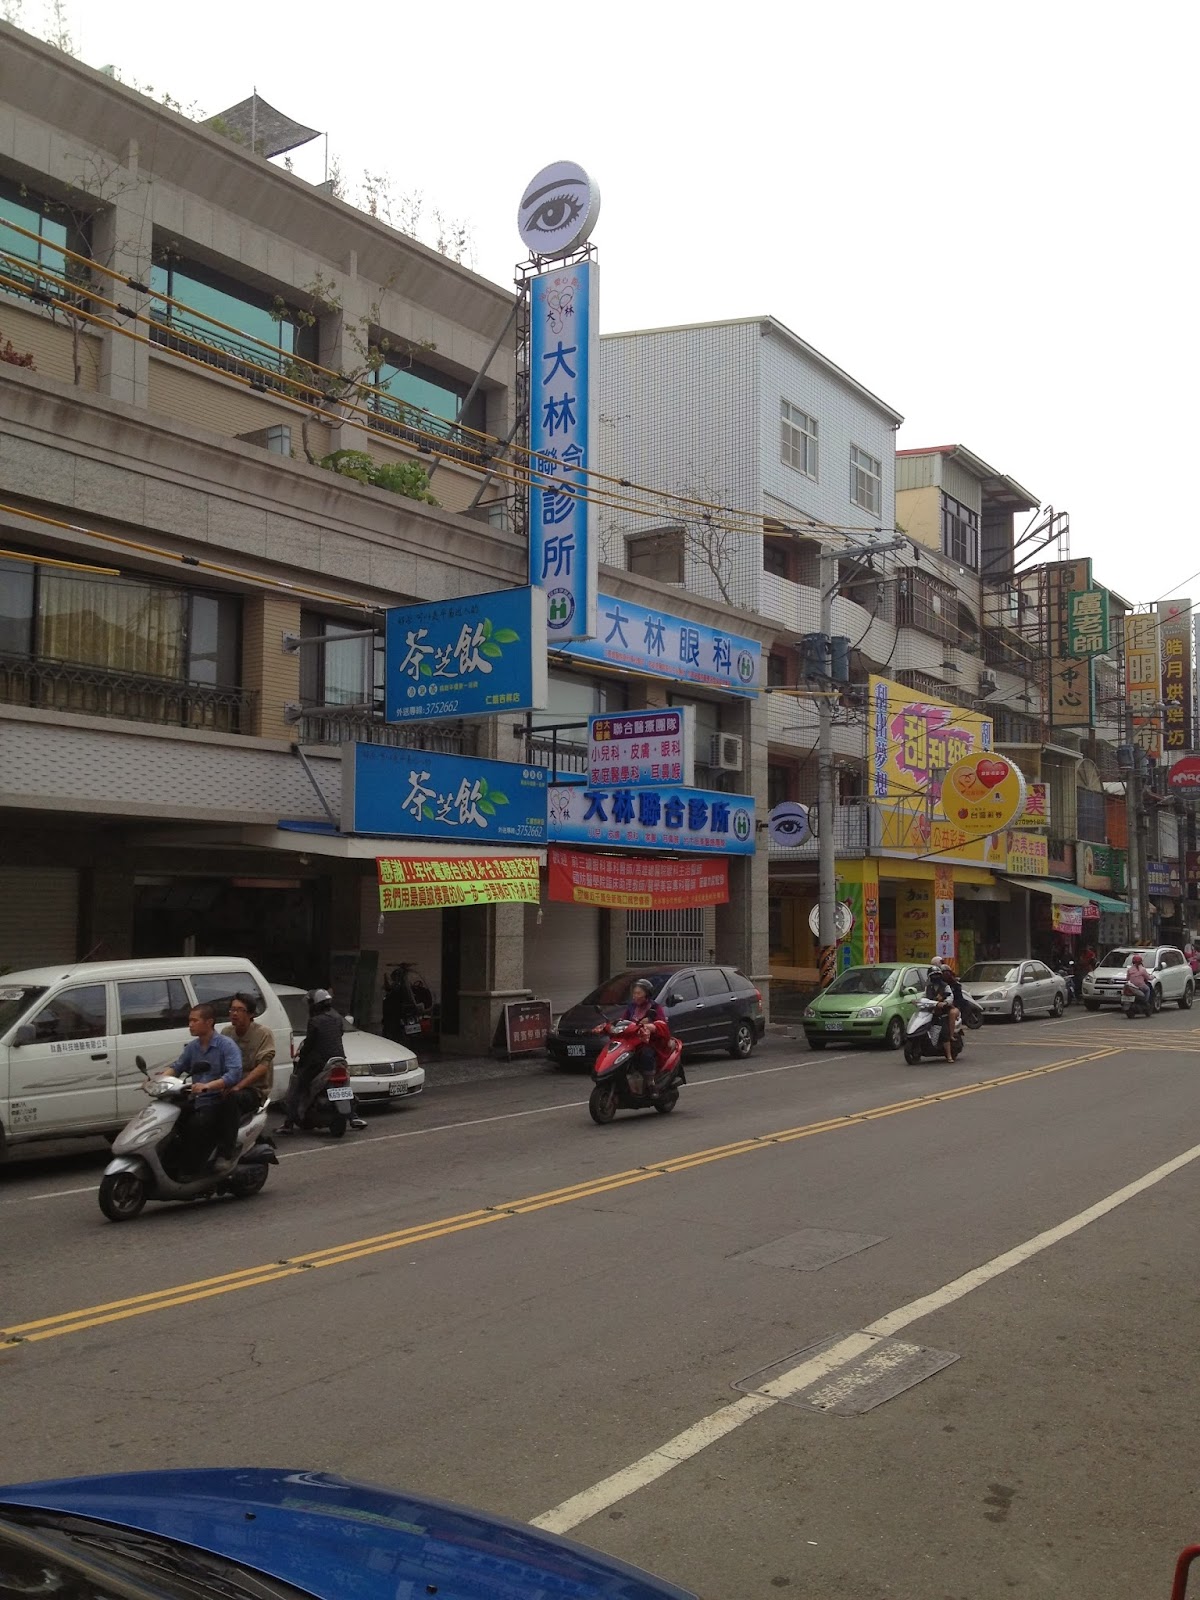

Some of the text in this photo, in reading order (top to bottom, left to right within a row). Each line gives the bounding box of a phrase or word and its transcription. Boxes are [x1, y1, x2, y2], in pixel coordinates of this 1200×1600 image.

[537, 341, 582, 579] 大林聯合診所
[400, 623, 492, 681] 茶芝飲
[604, 606, 731, 676] 大林眼科
[1072, 593, 1104, 653] 盧老師
[402, 771, 488, 828] 茶芝飲
[591, 763, 680, 784] 家庭醫學科 耳鼻喉
[583, 790, 730, 832] 大林聯合診所
